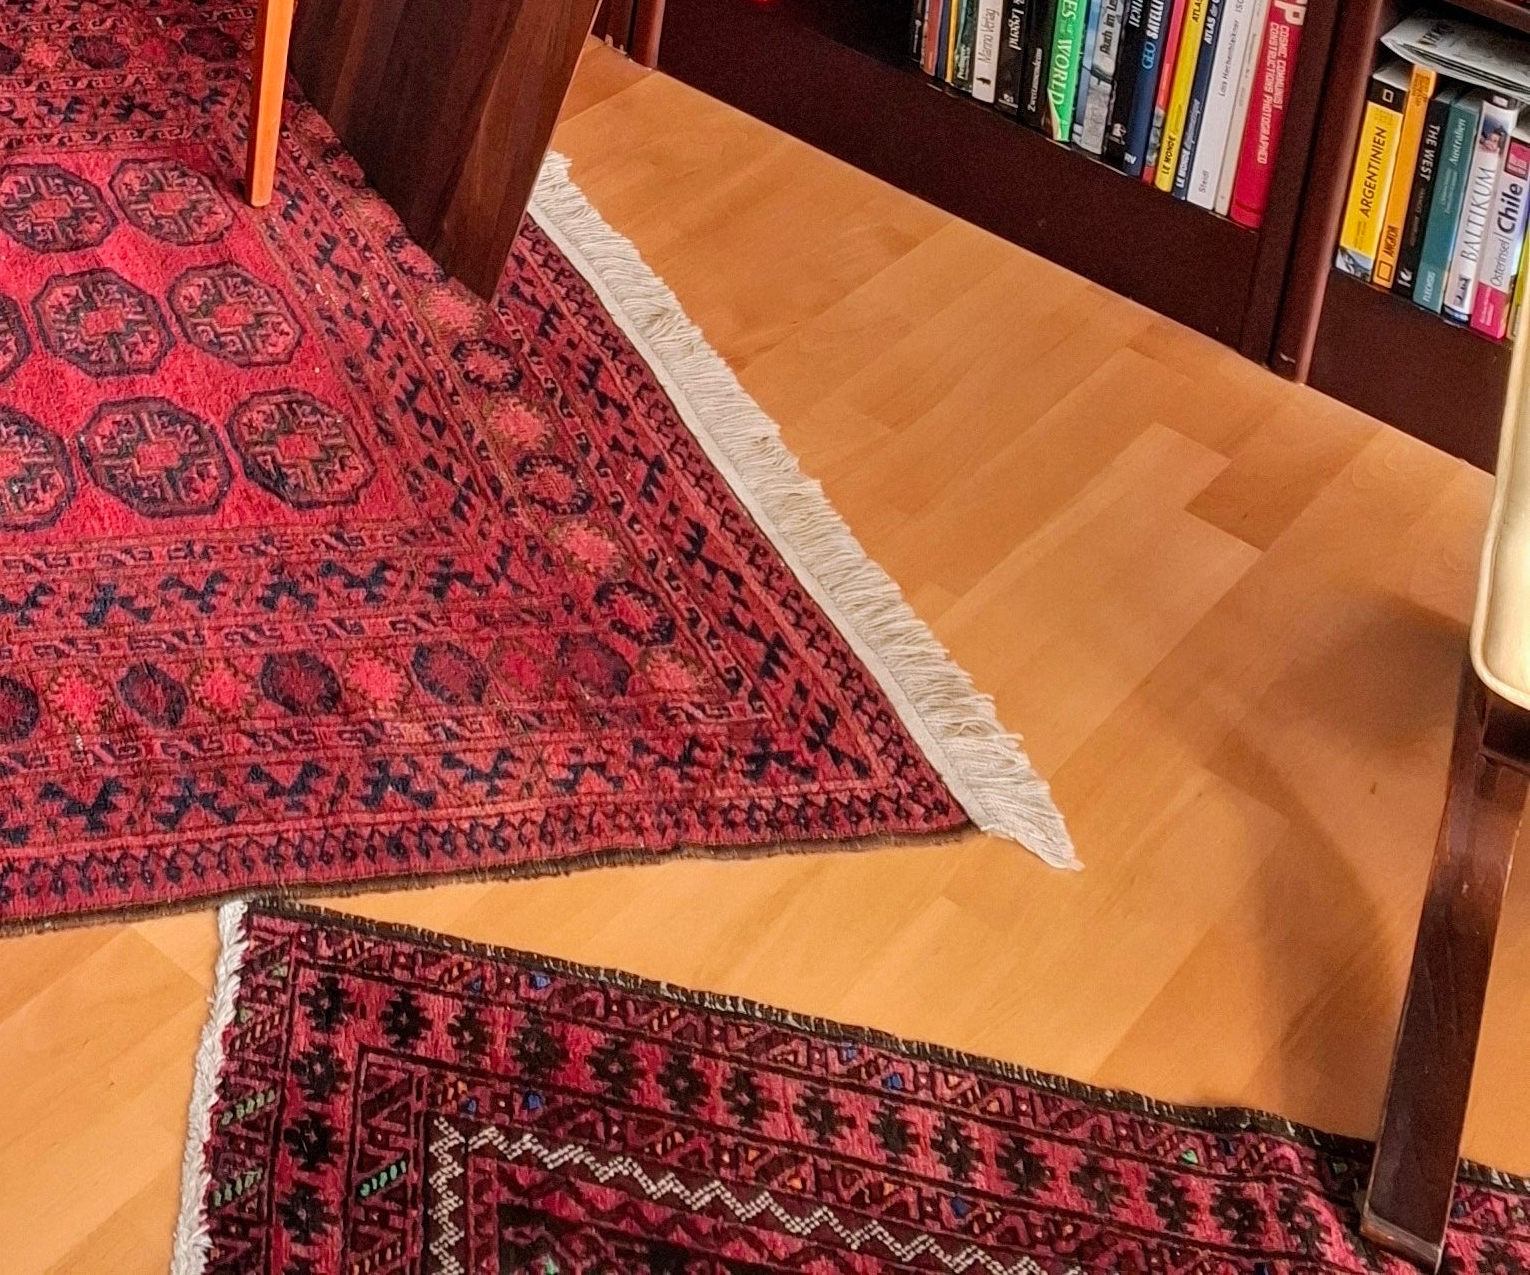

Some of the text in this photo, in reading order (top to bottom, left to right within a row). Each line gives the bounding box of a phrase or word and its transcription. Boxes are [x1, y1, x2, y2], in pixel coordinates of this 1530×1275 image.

[1009, 10, 1024, 50] Legend
[1203, 16, 1216, 45] ATLAS
[1278, 26, 1290, 63] COSMIC
[1050, 39, 1072, 106] WORLD
[1142, 43, 1156, 70] GEO
[1161, 135, 1177, 175] LE MONDE
[1420, 124, 1441, 182] THE WEST
[1448, 118, 1467, 167] Australien
[1360, 126, 1387, 219] ARGENTINIEN
[1460, 167, 1496, 261] BALTIKUM
[1489, 183, 1523, 288] Osterinsel Chile
